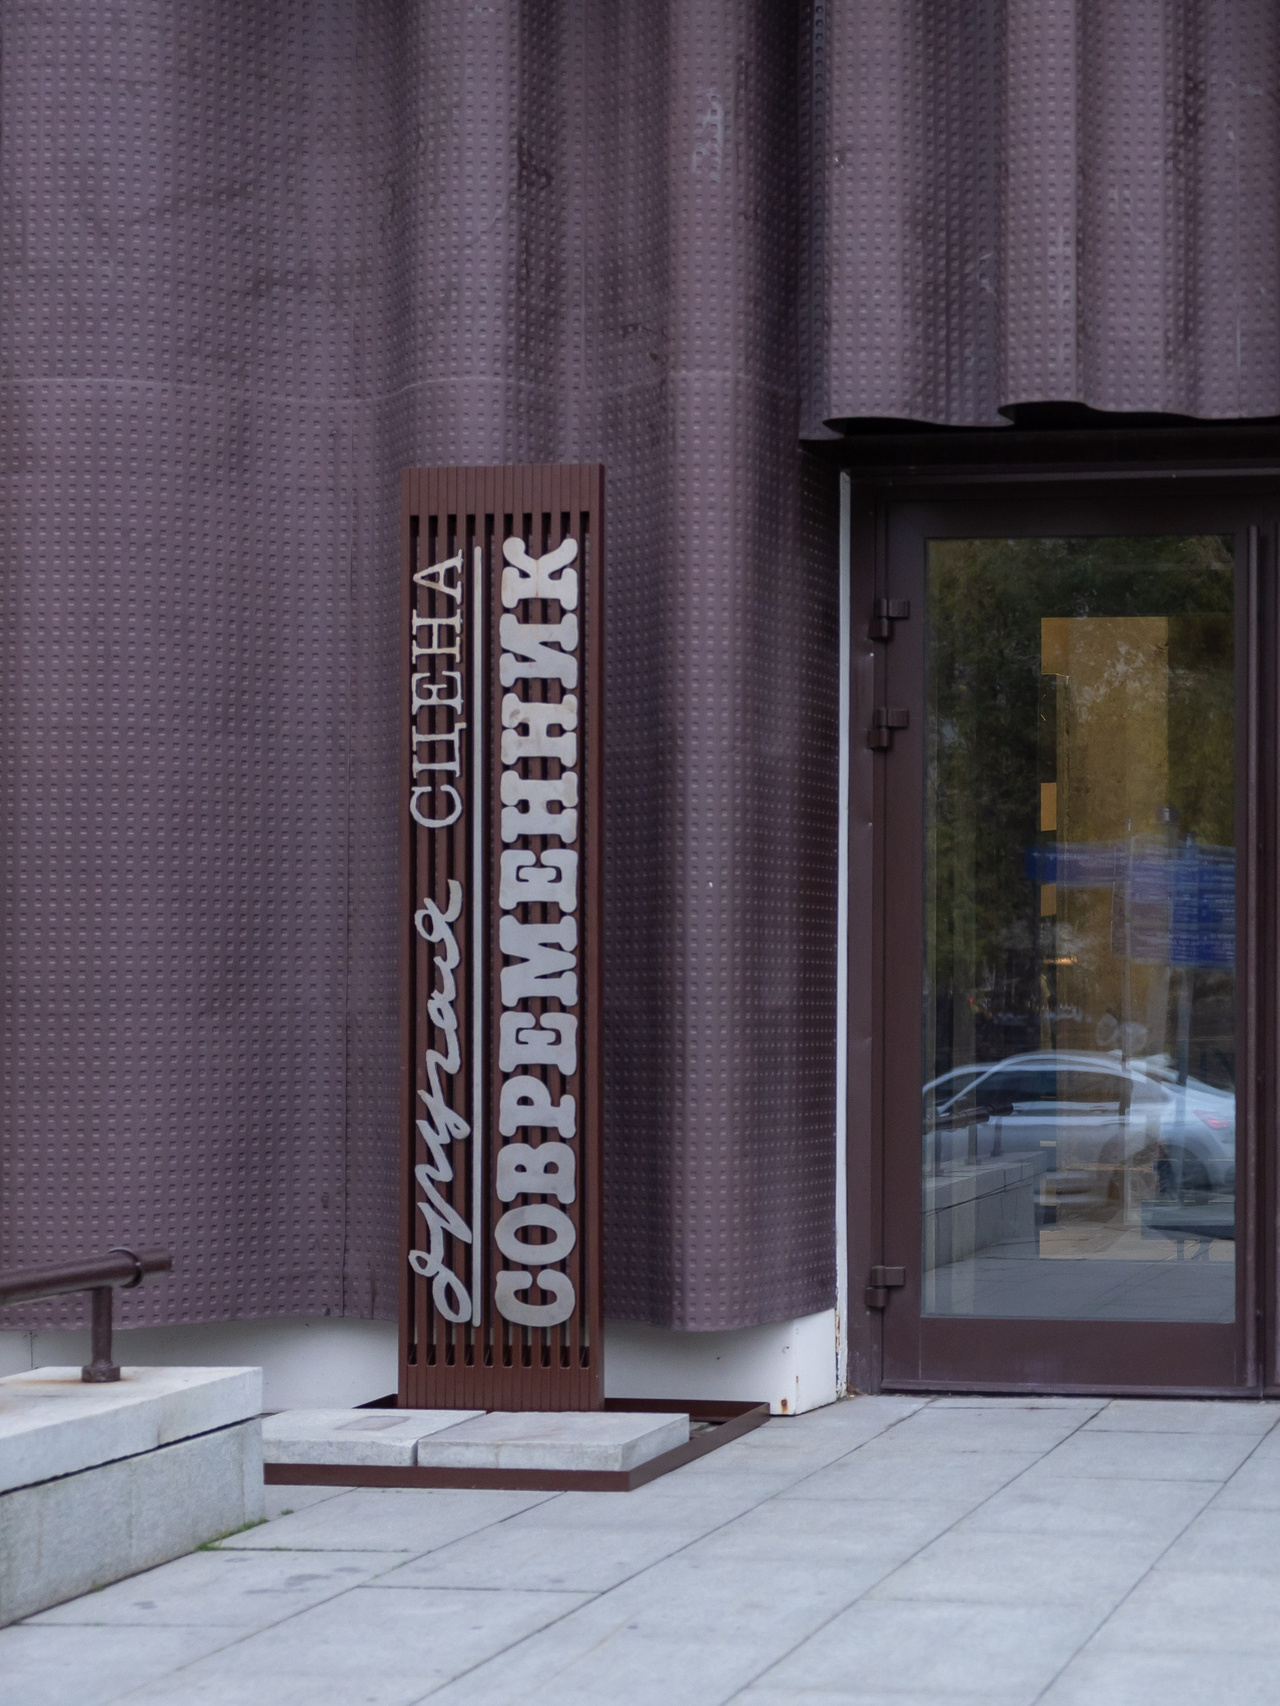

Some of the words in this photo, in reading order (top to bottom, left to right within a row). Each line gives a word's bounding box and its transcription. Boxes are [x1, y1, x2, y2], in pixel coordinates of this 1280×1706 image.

[410, 549, 466, 827] СЦЕНА
[408, 879, 472, 1323] другая
[494, 537, 578, 1328] СОВРЕМЕННИК
